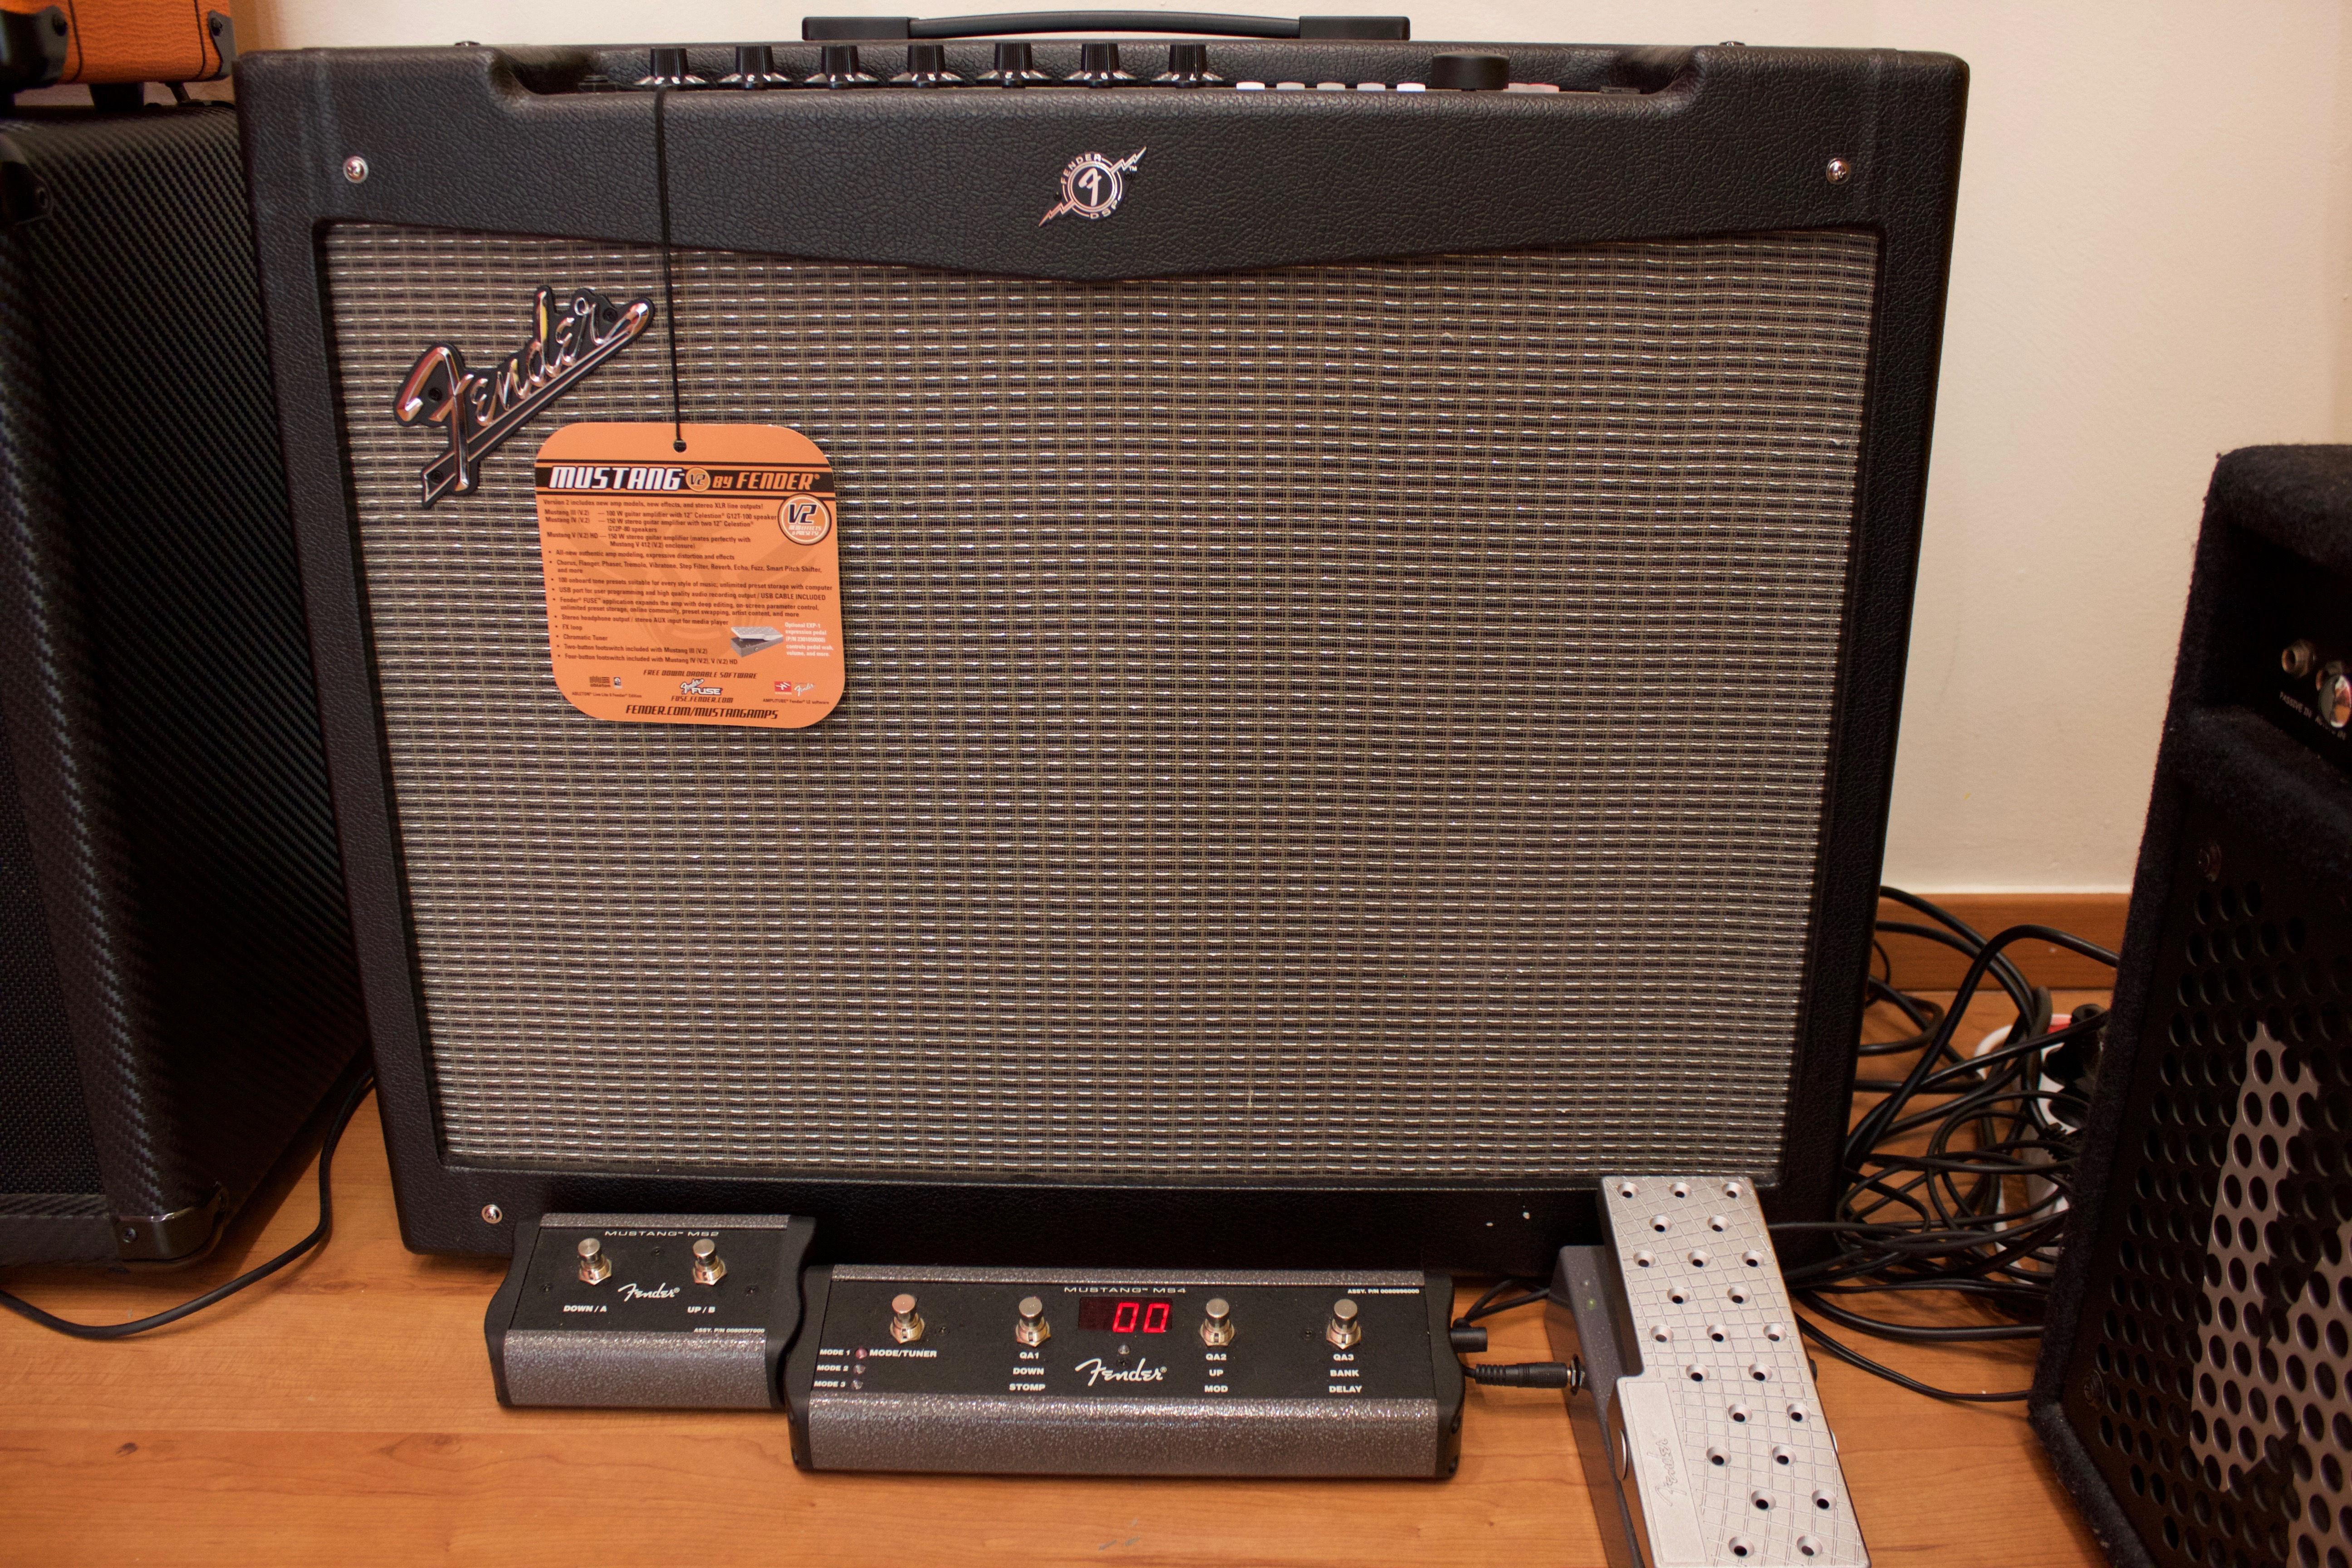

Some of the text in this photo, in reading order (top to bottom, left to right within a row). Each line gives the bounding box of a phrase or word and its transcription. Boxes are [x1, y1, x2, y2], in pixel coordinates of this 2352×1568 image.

[1061, 153, 1102, 184] FENDER
[1090, 200, 1117, 219] DSP
[395, 287, 652, 506] Fender
[548, 466, 682, 490] MUSTANG
[691, 687, 722, 695] FUSE
[626, 705, 779, 720] FENDER.COM/MUSTANGAMPS
[1112, 1302, 1170, 1333] 00
[869, 1349, 937, 1358] MODE/TUNER
[1013, 1367, 1044, 1375] DOWN
[1009, 1383, 1046, 1392] STOMP
[1329, 1385, 1362, 1393] DELAY
